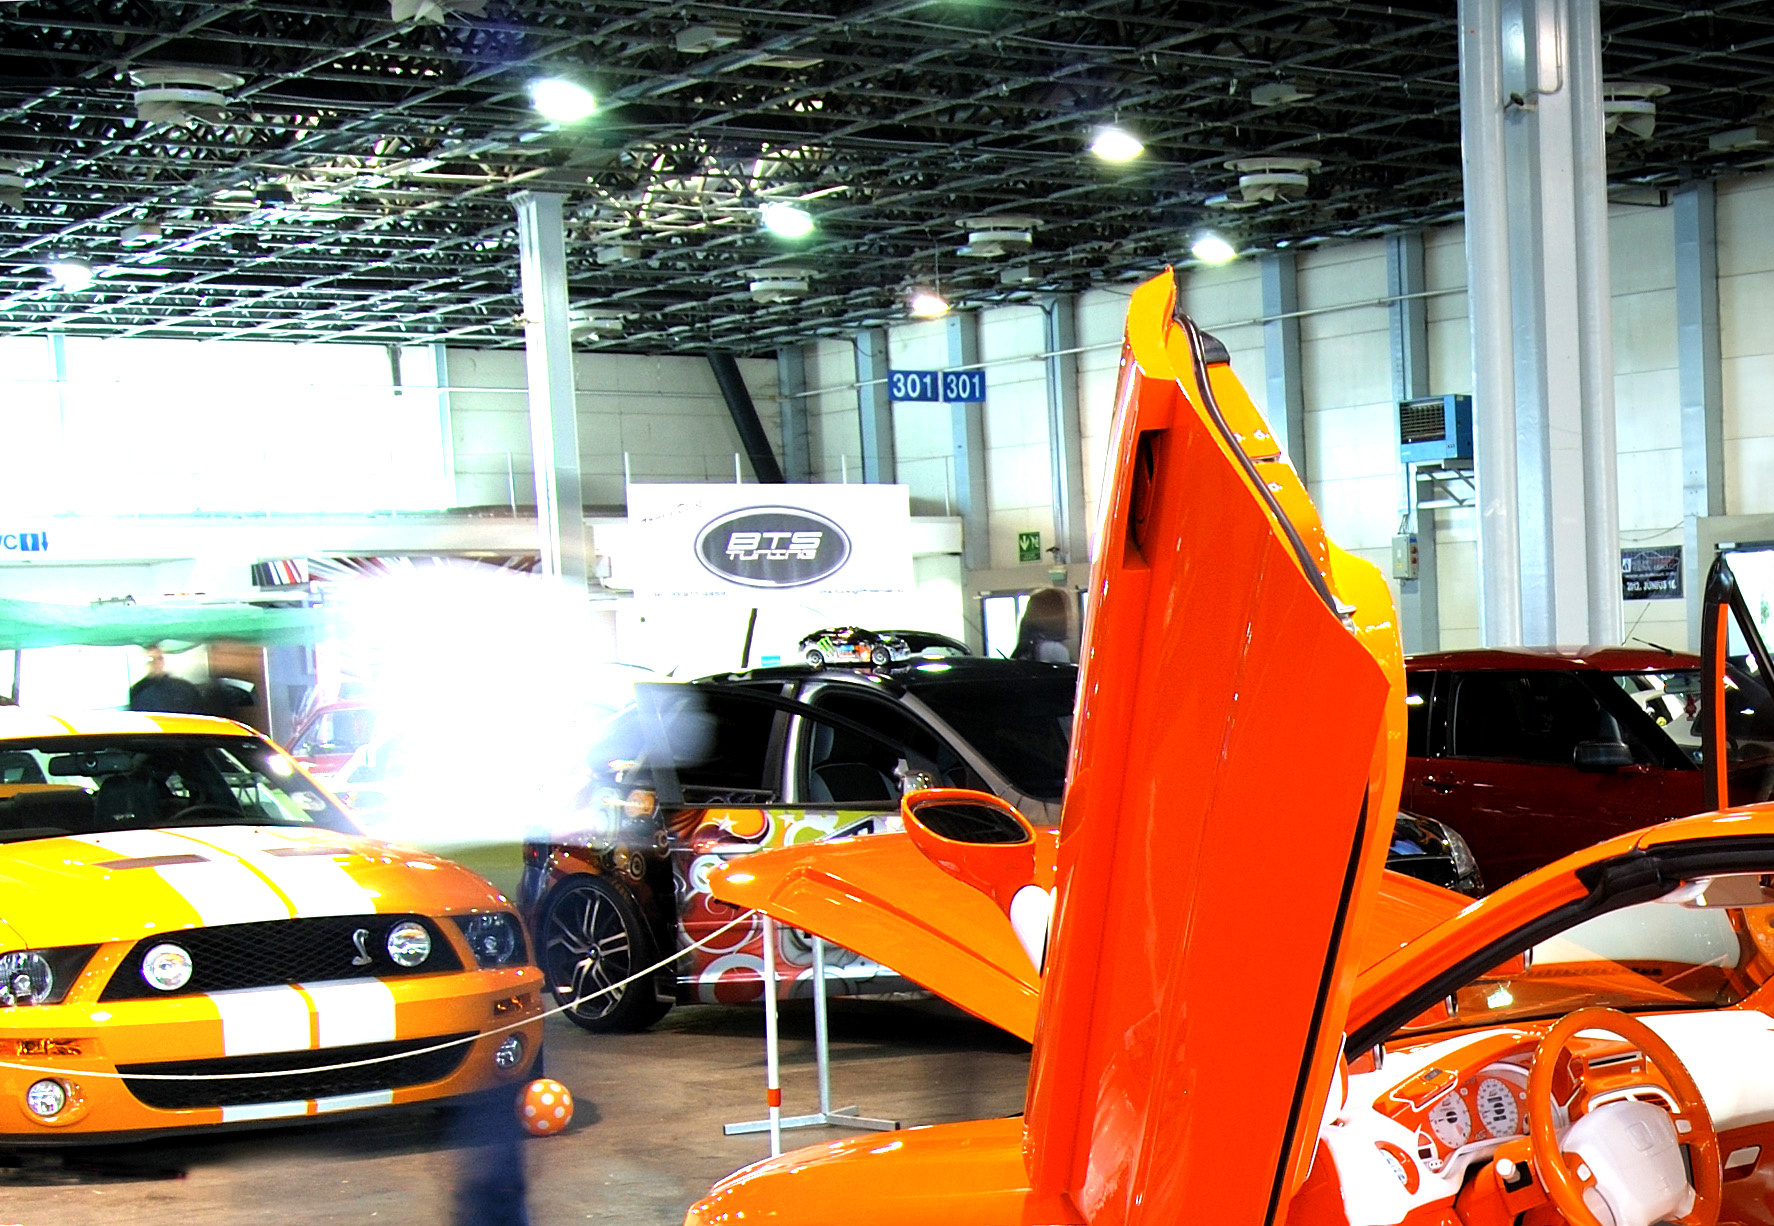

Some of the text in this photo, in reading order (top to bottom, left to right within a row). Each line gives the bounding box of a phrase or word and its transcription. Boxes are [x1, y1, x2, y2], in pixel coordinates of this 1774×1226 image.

[892, 372, 933, 399] 301
[946, 374, 981, 399] 301
[0, 534, 18, 551] C
[727, 531, 823, 551] BTS
[725, 549, 817, 561] TUNING
